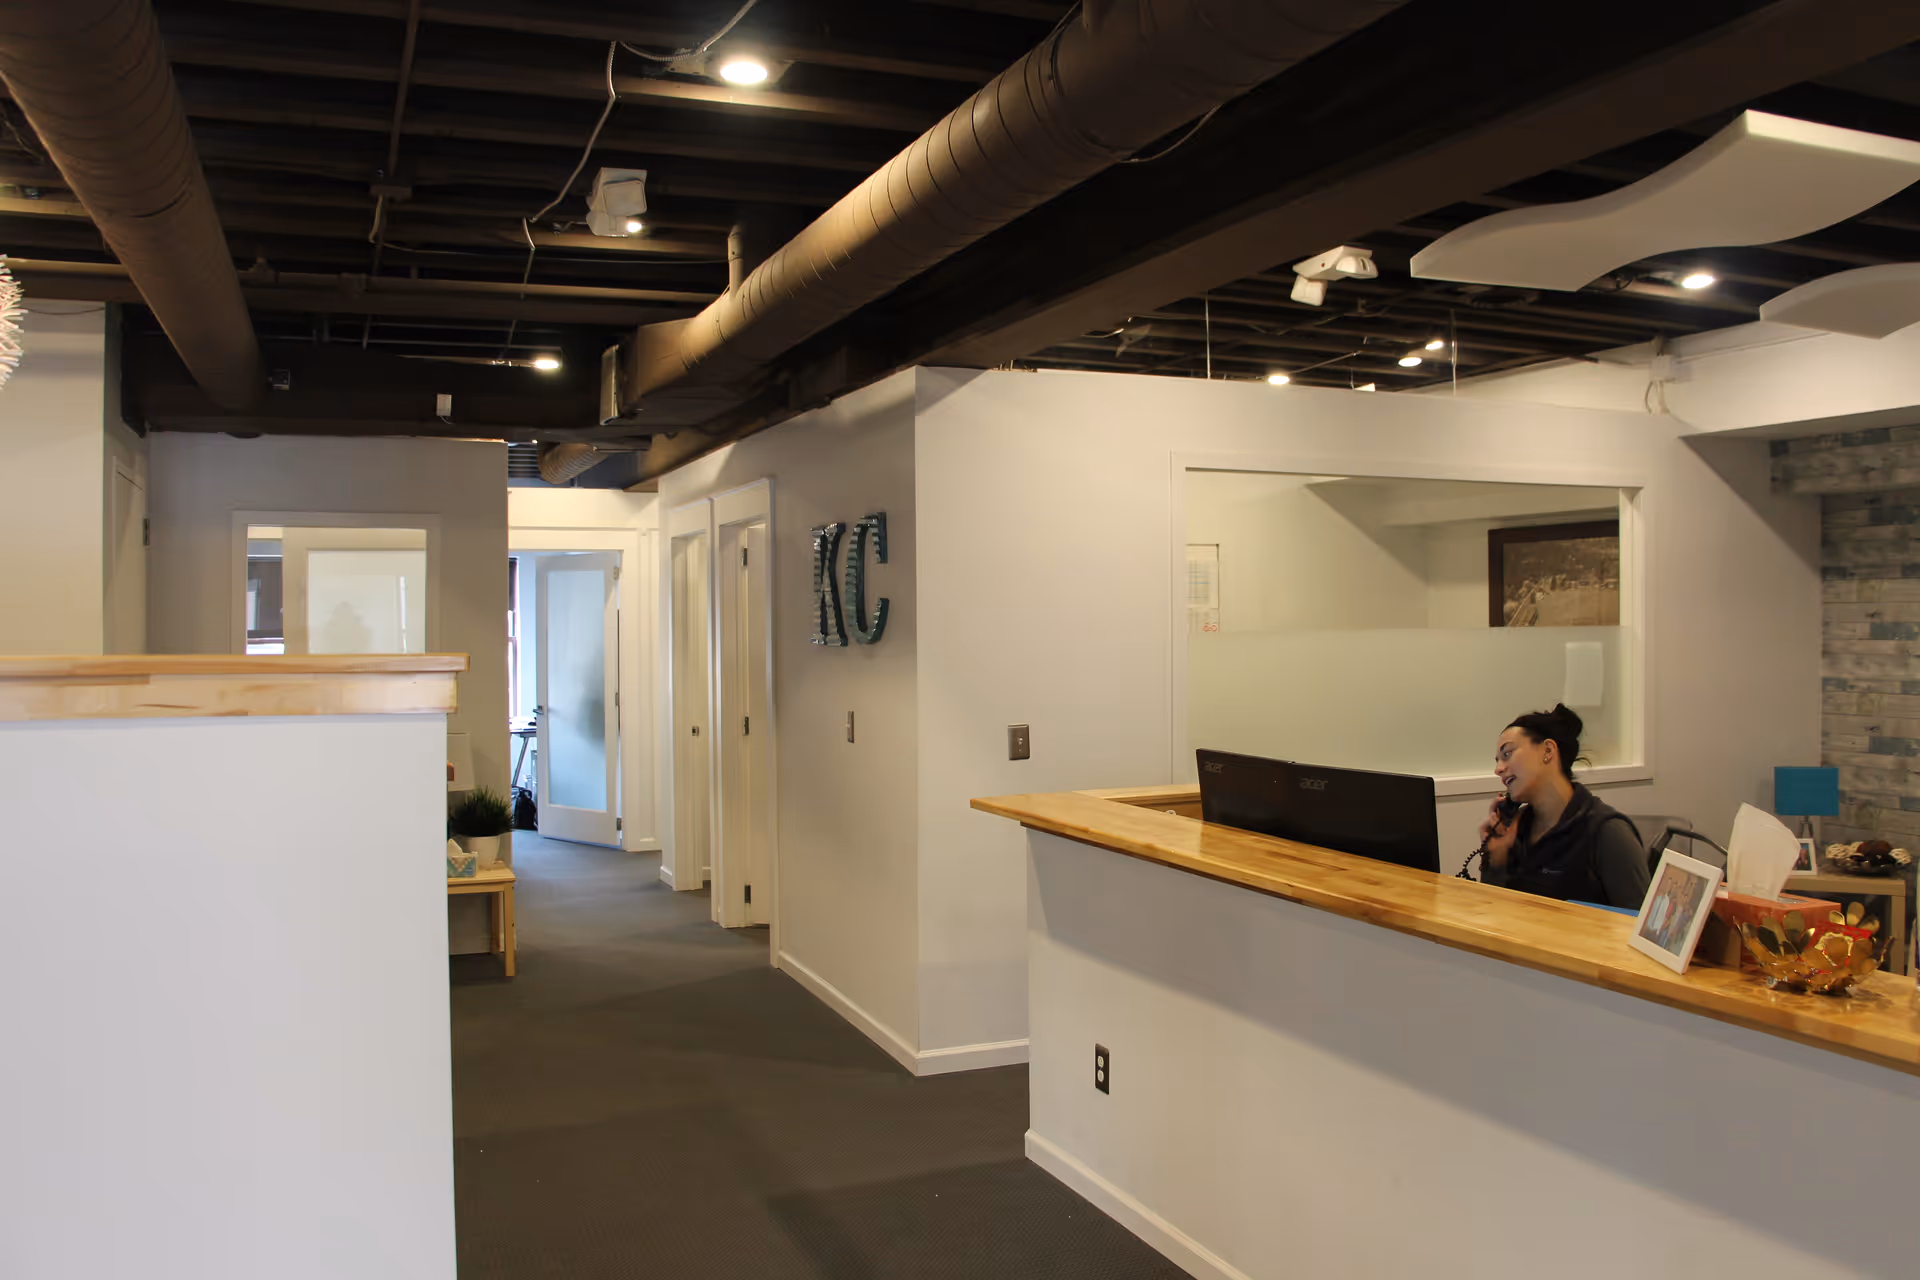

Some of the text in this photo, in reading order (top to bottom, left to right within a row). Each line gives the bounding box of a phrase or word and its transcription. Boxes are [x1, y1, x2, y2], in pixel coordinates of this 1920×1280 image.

[809, 511, 889, 647] KC
[1203, 760, 1224, 774] acer
[1299, 777, 1329, 791] acer
